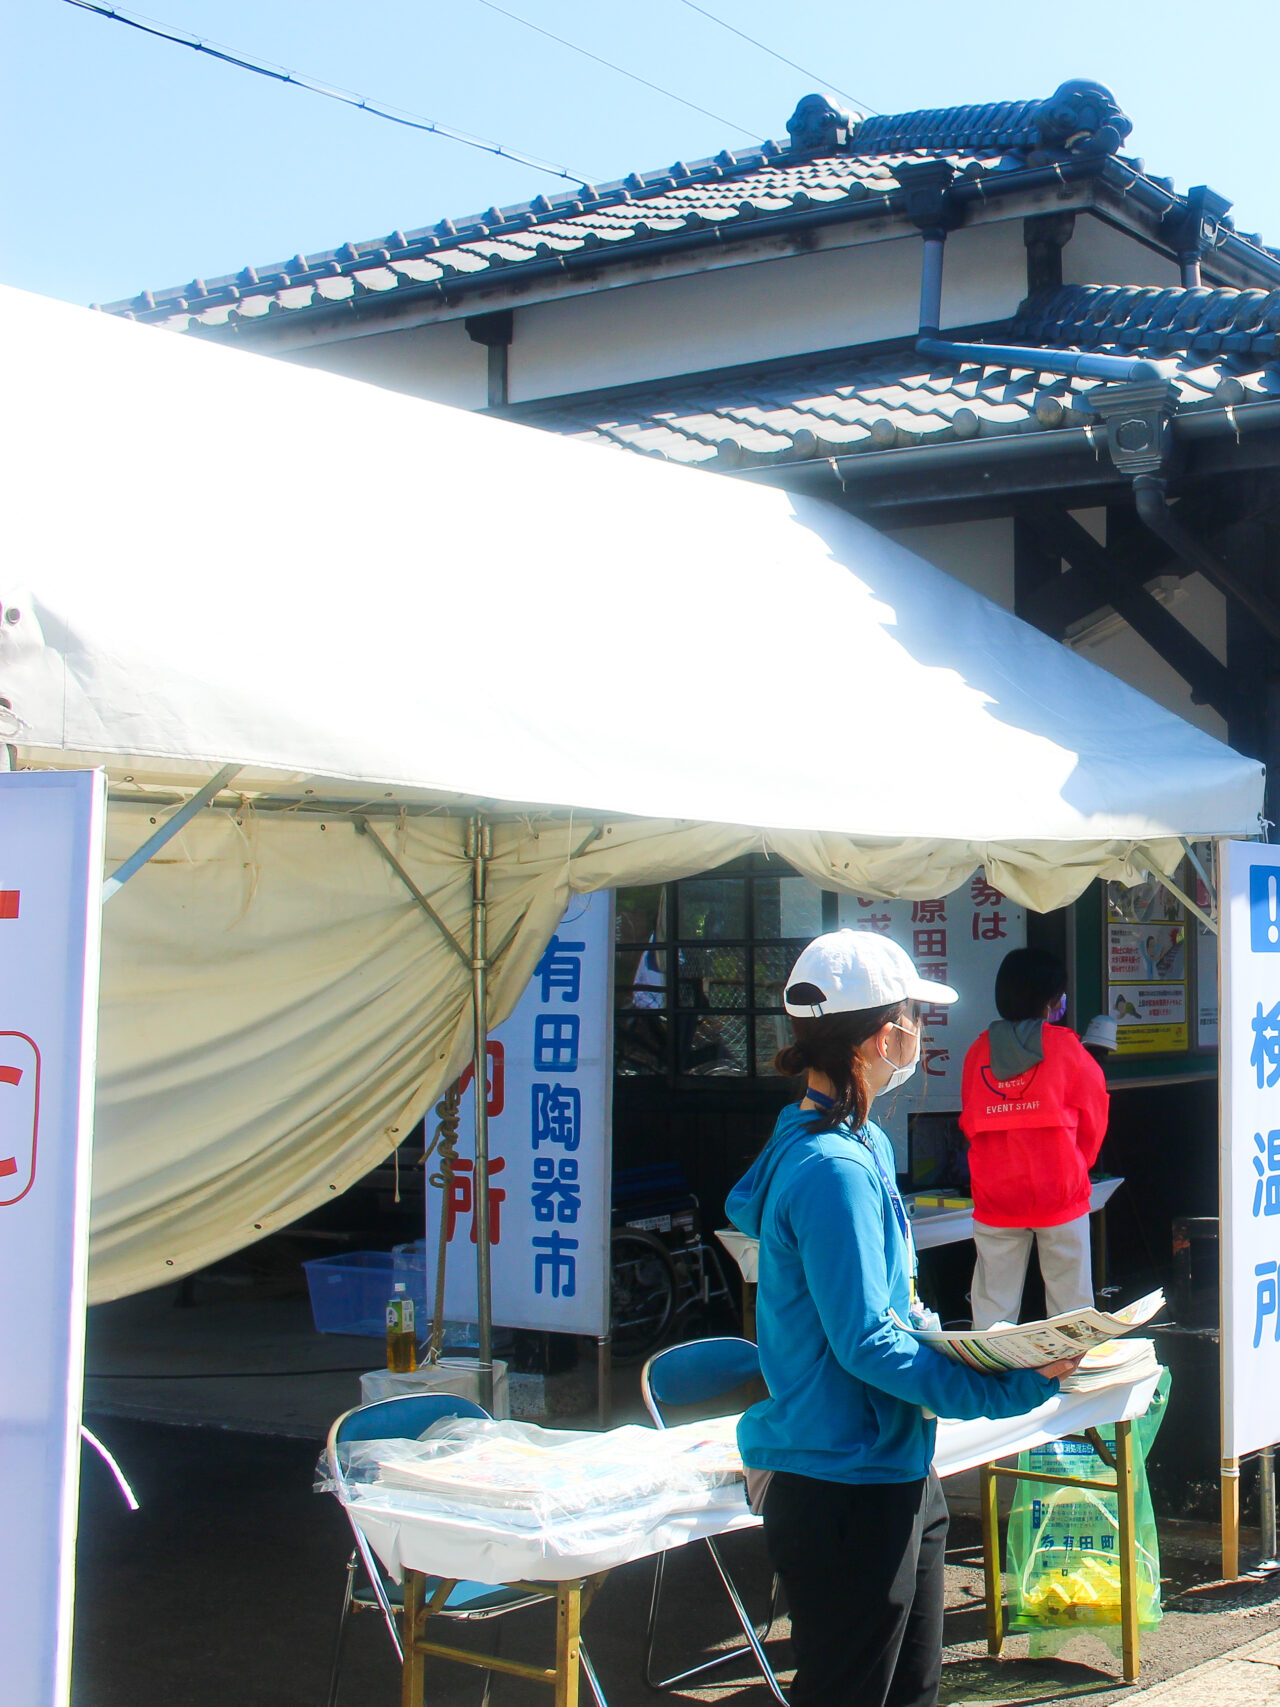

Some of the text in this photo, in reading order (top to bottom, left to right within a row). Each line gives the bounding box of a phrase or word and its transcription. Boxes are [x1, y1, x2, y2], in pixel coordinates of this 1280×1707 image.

[531, 934, 585, 1298] 有田陶器市
[986, 1100, 1041, 1115] EVENT STAFF
